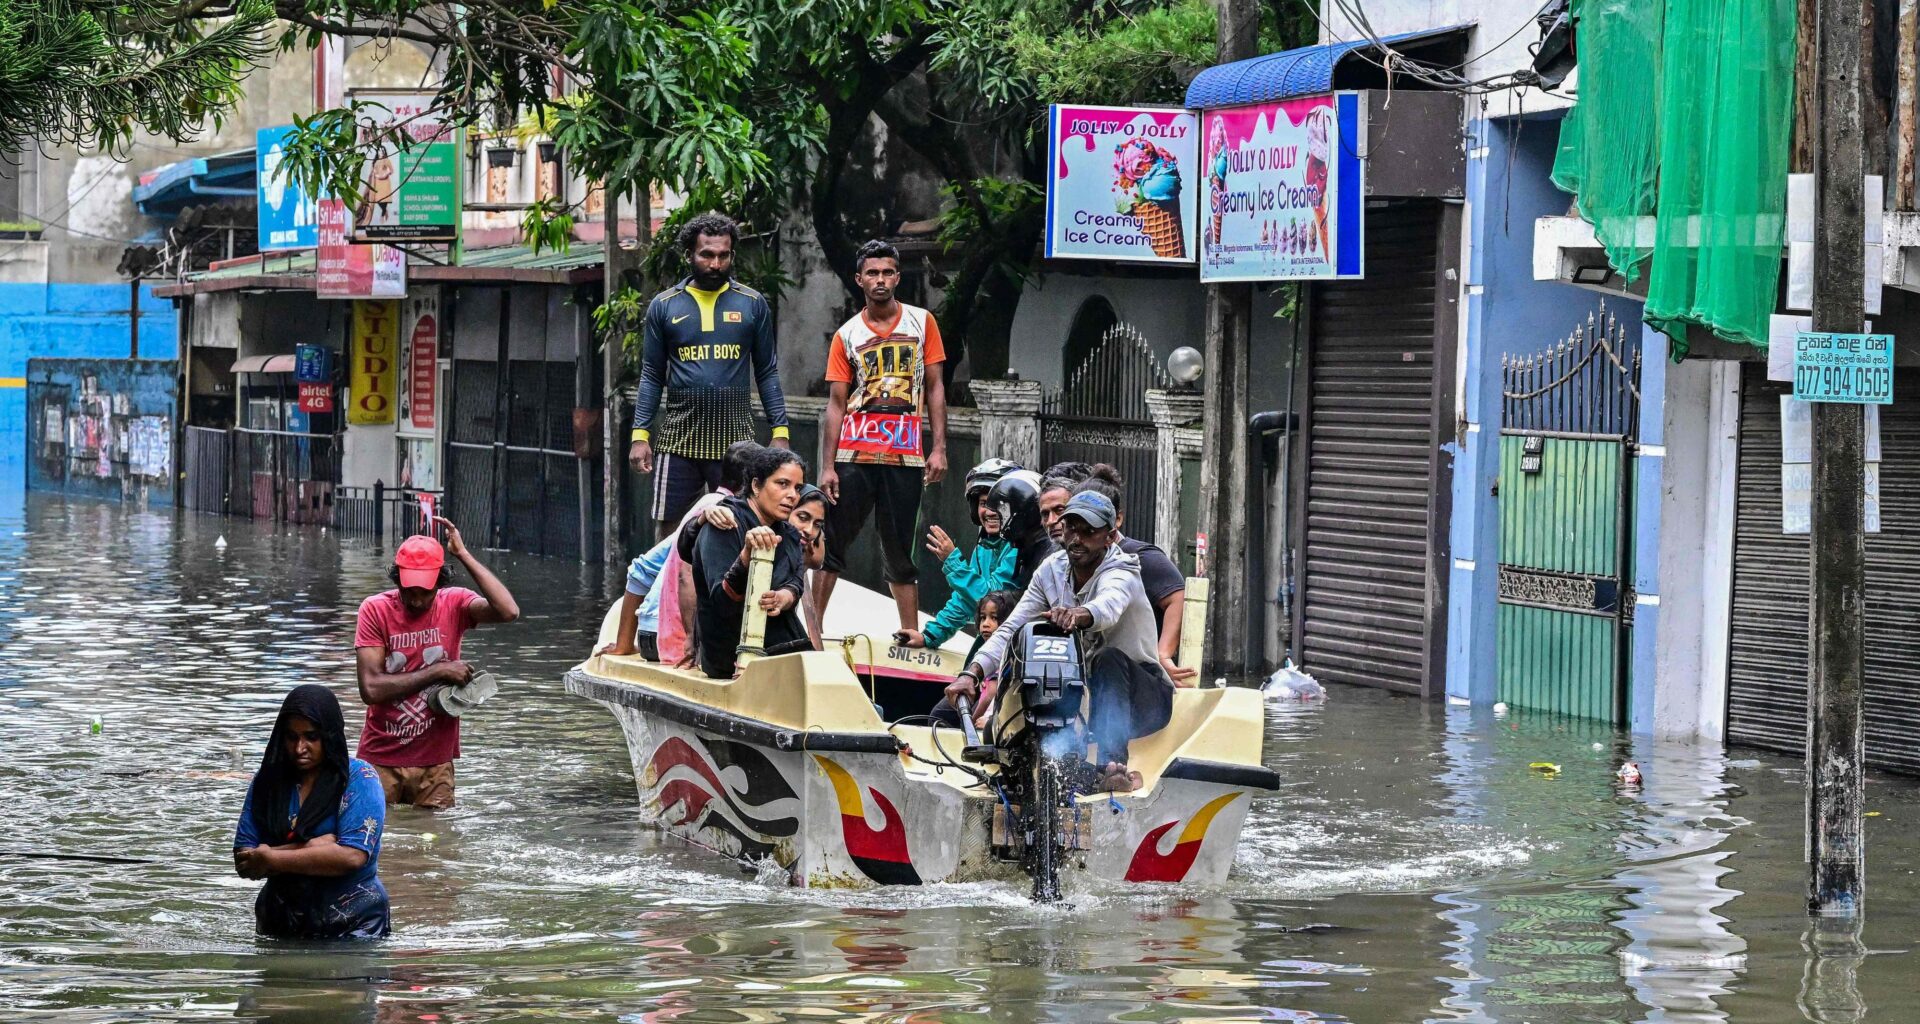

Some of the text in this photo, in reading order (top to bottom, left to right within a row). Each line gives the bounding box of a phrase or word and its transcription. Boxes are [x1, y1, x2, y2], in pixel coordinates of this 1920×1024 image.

[1070, 119, 1187, 138] JOLLY O JOLLY
[1228, 145, 1298, 173] JOLLY O JOLLY
[1211, 182, 1320, 220] Creamy Ice Cream
[320, 206, 344, 224] Sri Lank
[1074, 210, 1144, 232] Creamy
[328, 228, 349, 246] Netw
[1065, 228, 1152, 247] Ice Cream
[360, 299, 388, 412] STUDIO
[678, 344, 740, 361] GREAT BOYS
[1797, 365, 1890, 397] 077 904 0503
[301, 385, 330, 397] airtel
[306, 398, 324, 408] 4G
[888, 645, 941, 667] SNL-514
[1034, 639, 1068, 655] 25
